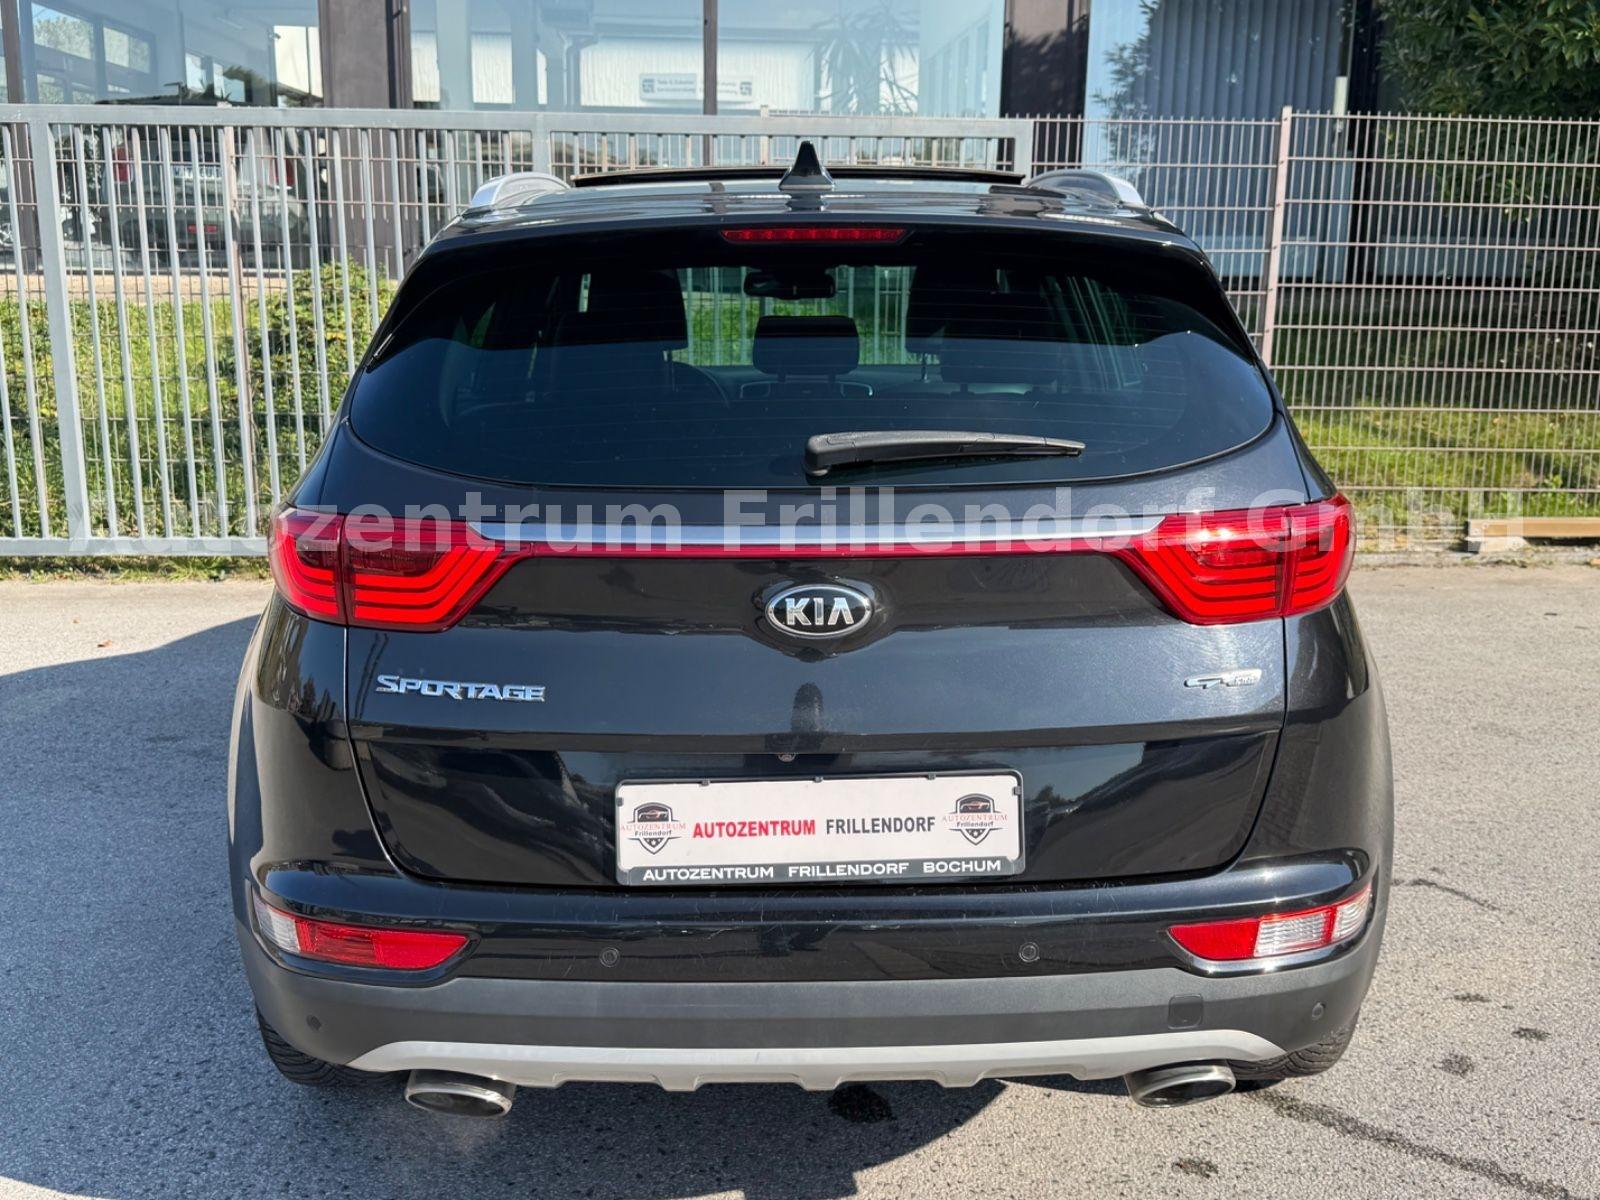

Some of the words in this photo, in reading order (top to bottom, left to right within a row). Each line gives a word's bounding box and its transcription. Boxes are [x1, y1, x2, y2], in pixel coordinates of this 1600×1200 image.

[785, 597, 854, 625] KIA
[376, 674, 546, 702] SPORTAGE
[692, 820, 815, 838] AUTOZENTRUM
[826, 817, 935, 835] FRILLENDORF
[643, 867, 774, 881] AUTOZENTRUM
[788, 862, 910, 877] FRILLENDORF
[923, 860, 1001, 874] BOCHUM
